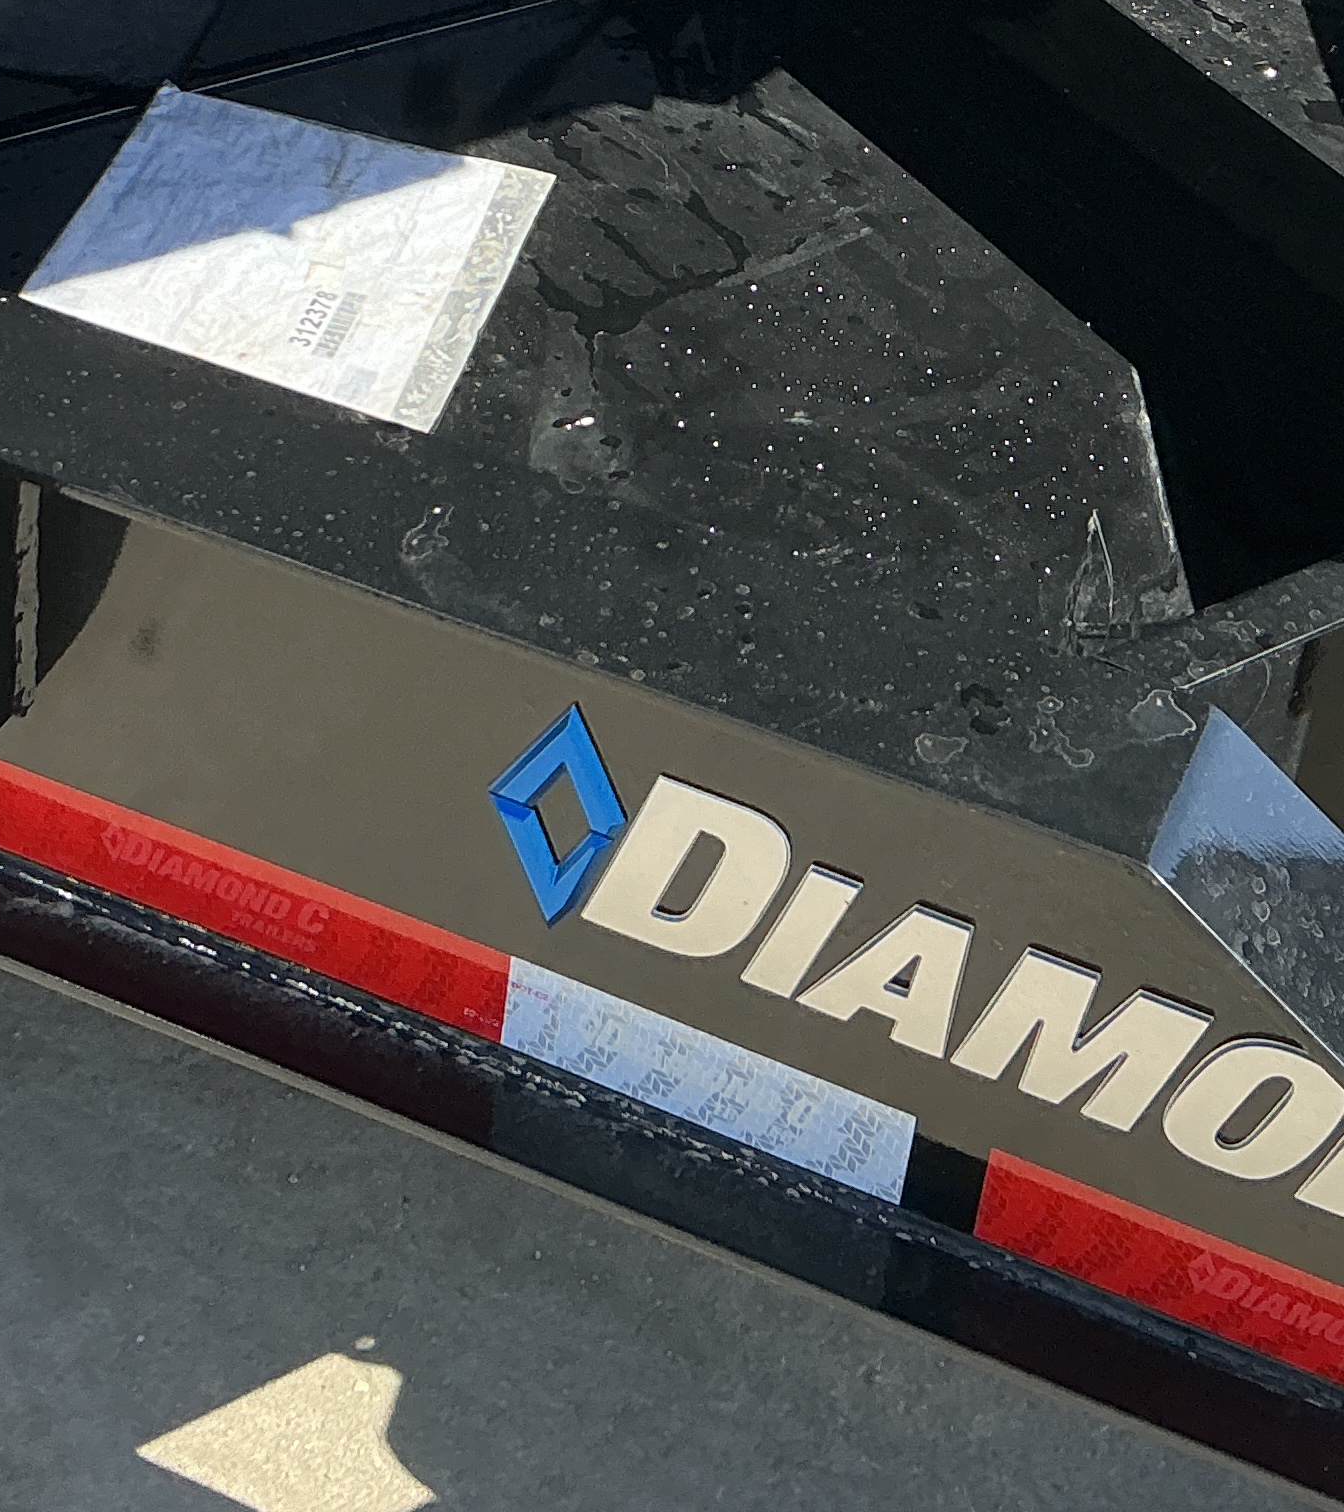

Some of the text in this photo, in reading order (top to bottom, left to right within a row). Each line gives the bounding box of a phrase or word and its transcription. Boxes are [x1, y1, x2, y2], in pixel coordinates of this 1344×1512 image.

[288, 290, 338, 347] 312378
[119, 834, 331, 935] DIAMOND C
